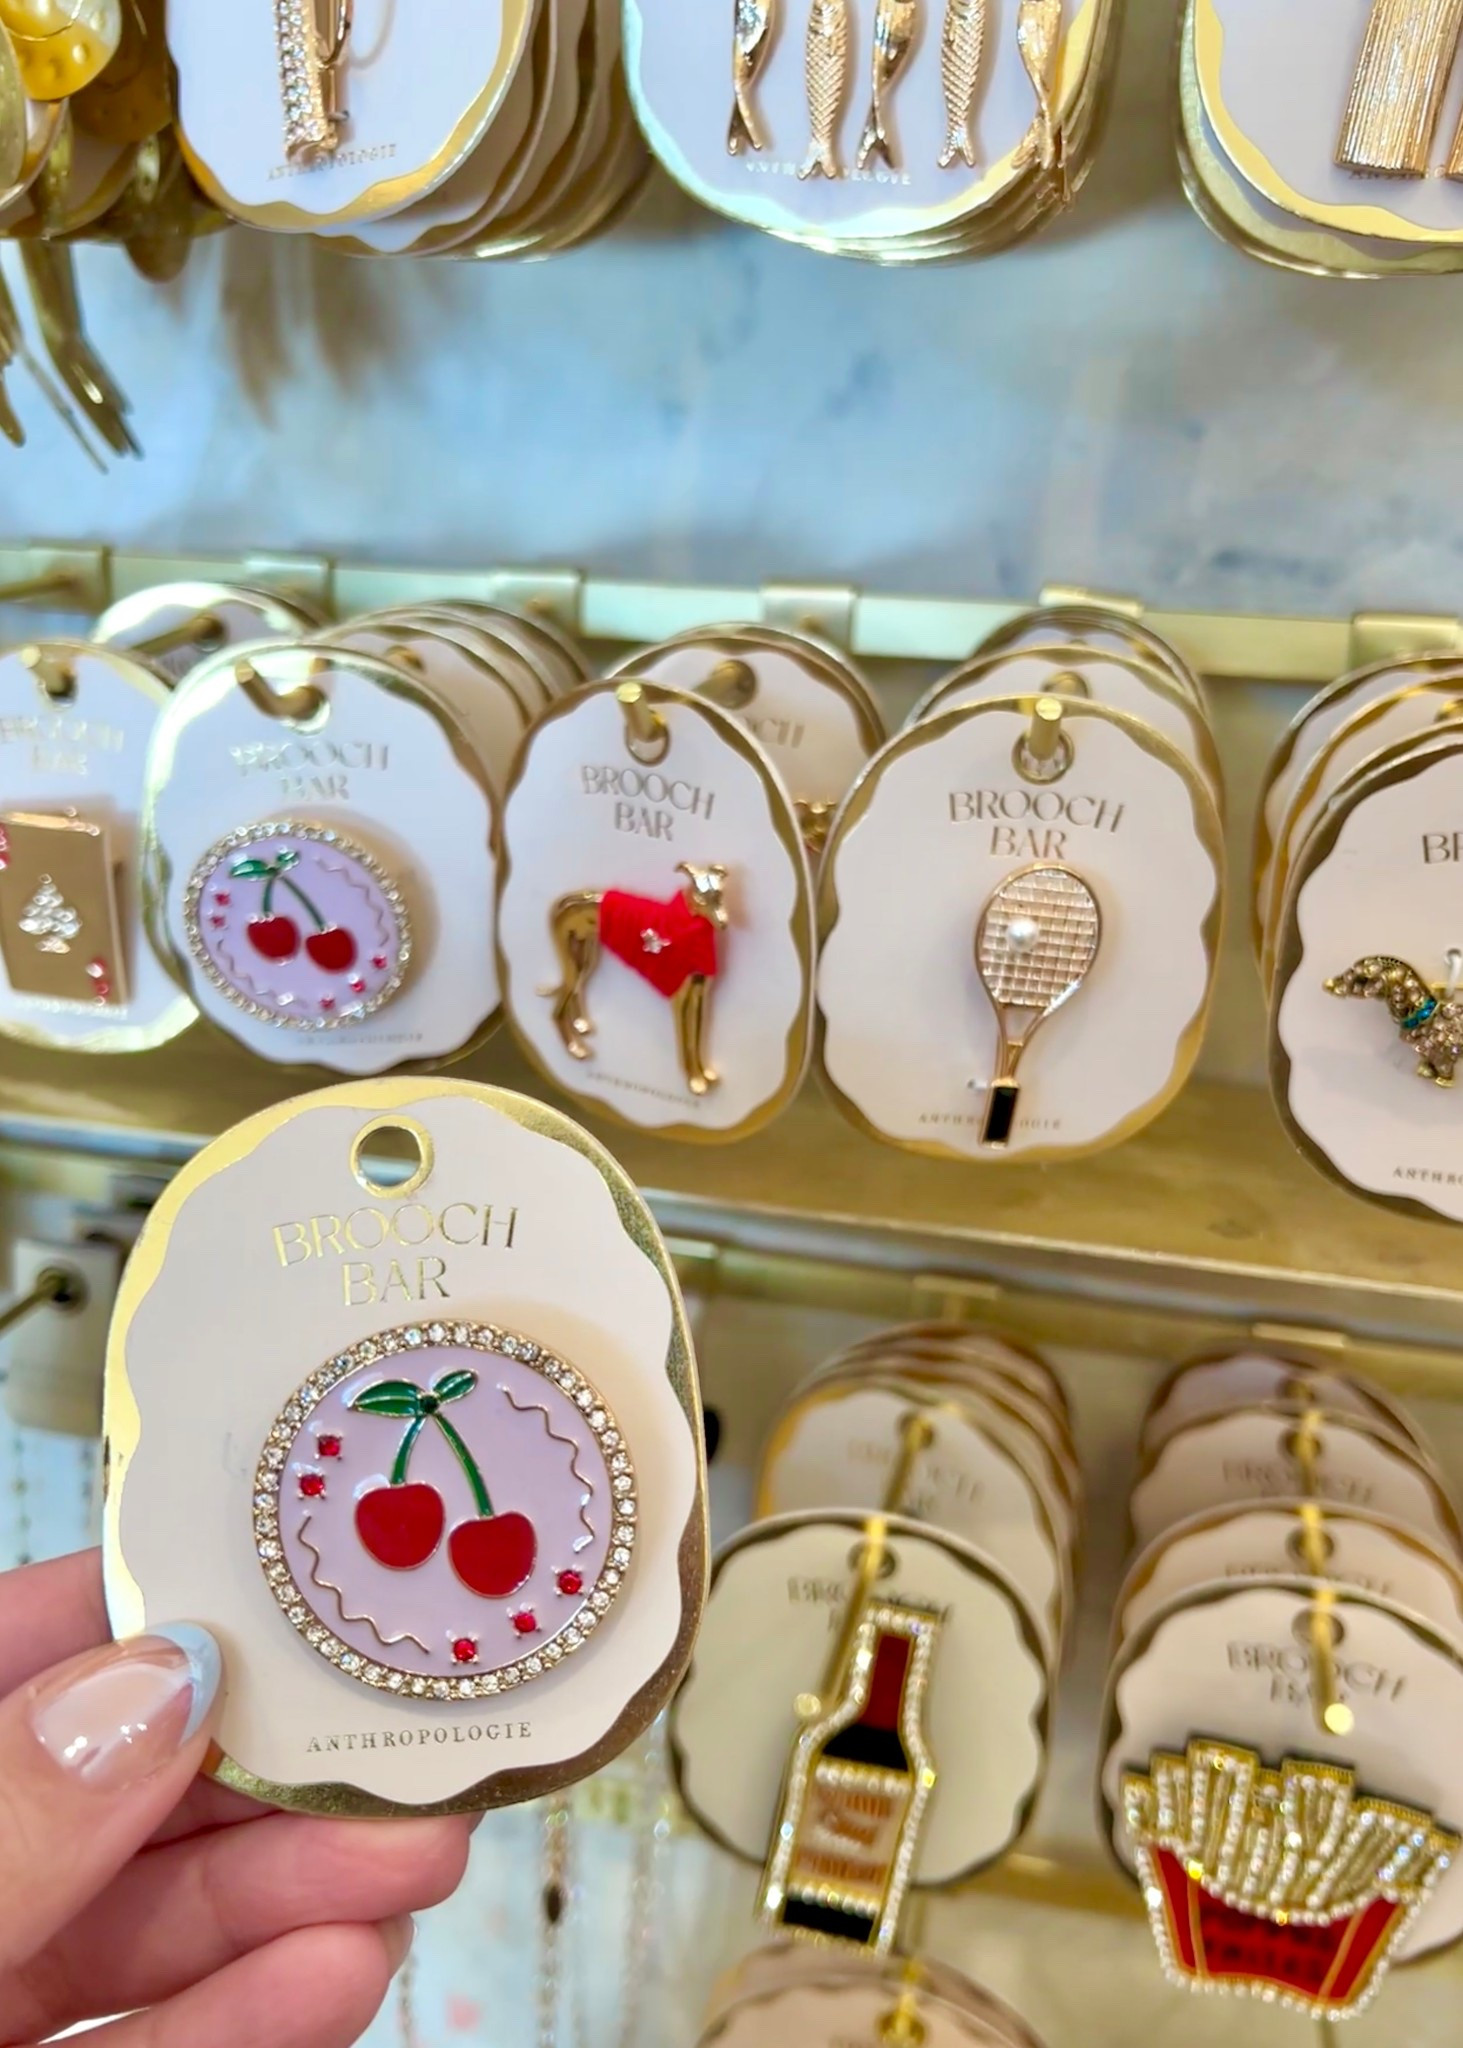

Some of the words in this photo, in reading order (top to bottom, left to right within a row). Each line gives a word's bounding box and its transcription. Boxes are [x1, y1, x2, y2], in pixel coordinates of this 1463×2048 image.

[228, 741, 389, 777] BROOCH
[279, 774, 351, 801] BAR
[579, 765, 715, 820] BROOCH
[614, 801, 674, 842] BAR
[949, 789, 1125, 833] BROOCH
[990, 826, 1066, 860] BAR
[272, 1202, 519, 1267] BROOCH
[341, 1255, 451, 1306] BAR
[1227, 1640, 1407, 1702] BROCH
[306, 1721, 533, 1753] ANTHROPOLOGIE
